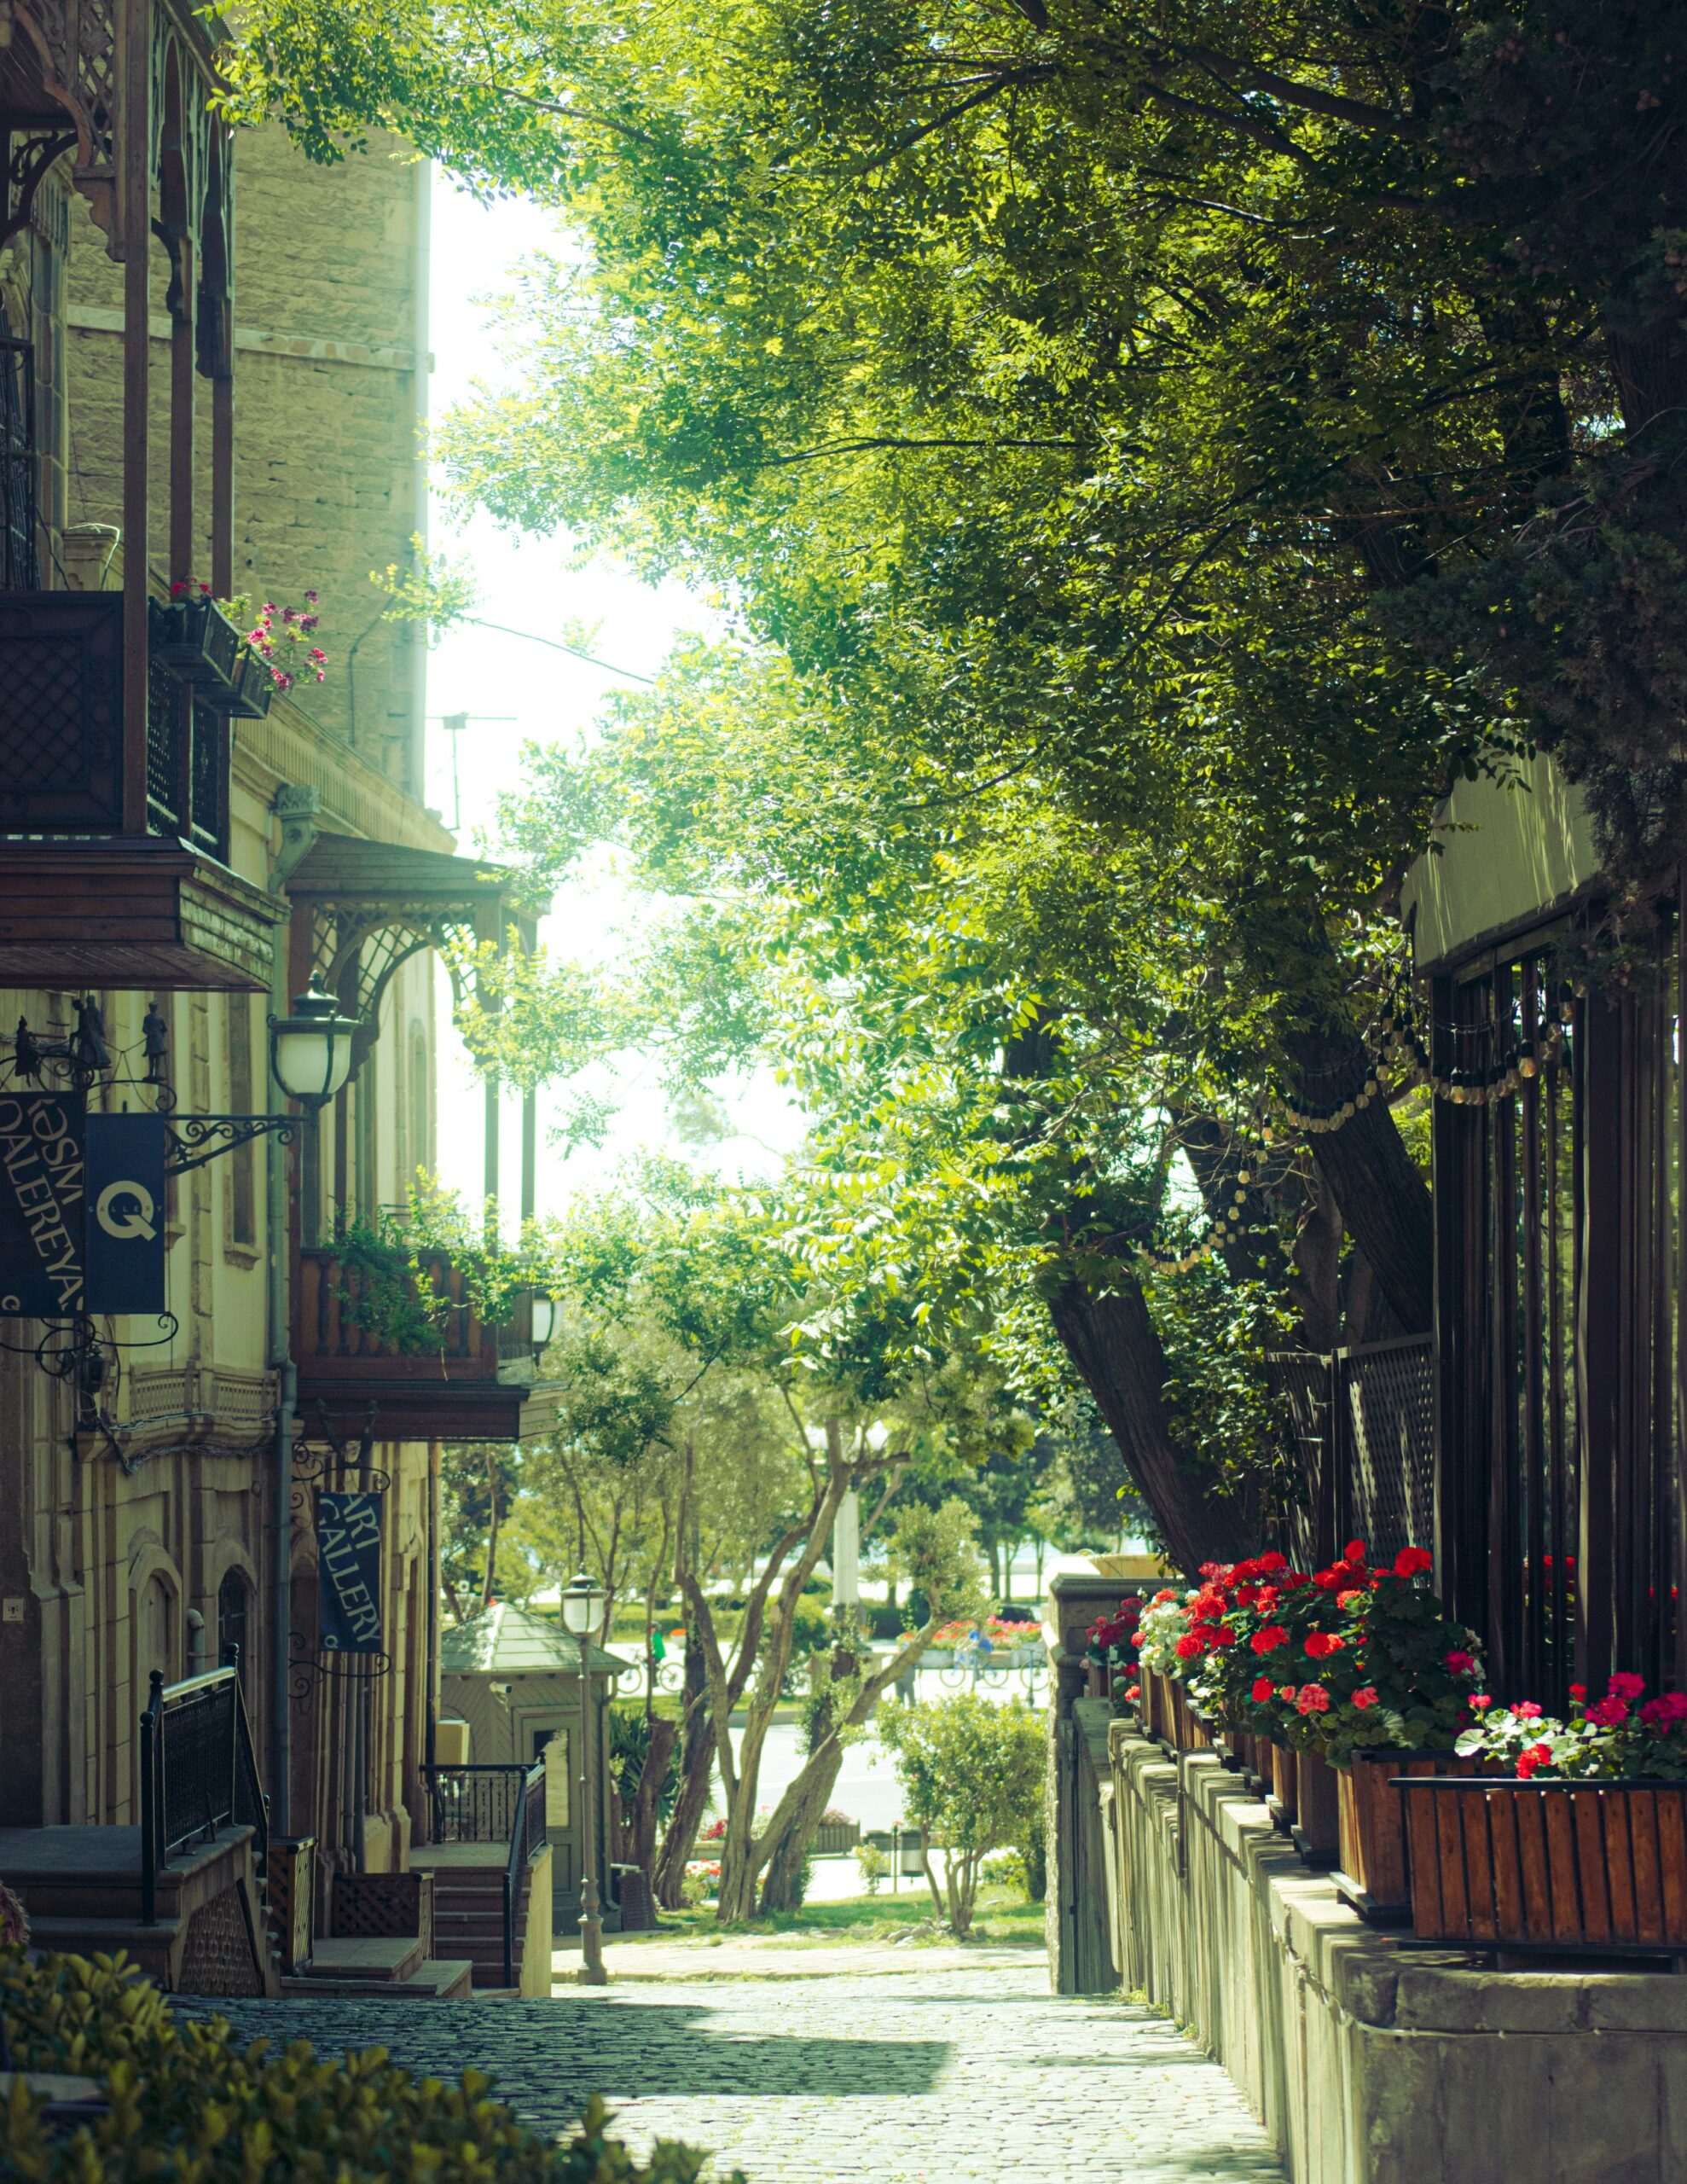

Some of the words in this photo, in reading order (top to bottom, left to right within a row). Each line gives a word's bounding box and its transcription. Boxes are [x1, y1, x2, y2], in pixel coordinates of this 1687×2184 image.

[96, 1180, 157, 1241] Q
[343, 1492, 380, 1549] ART
[324, 1635, 339, 1649] Q
